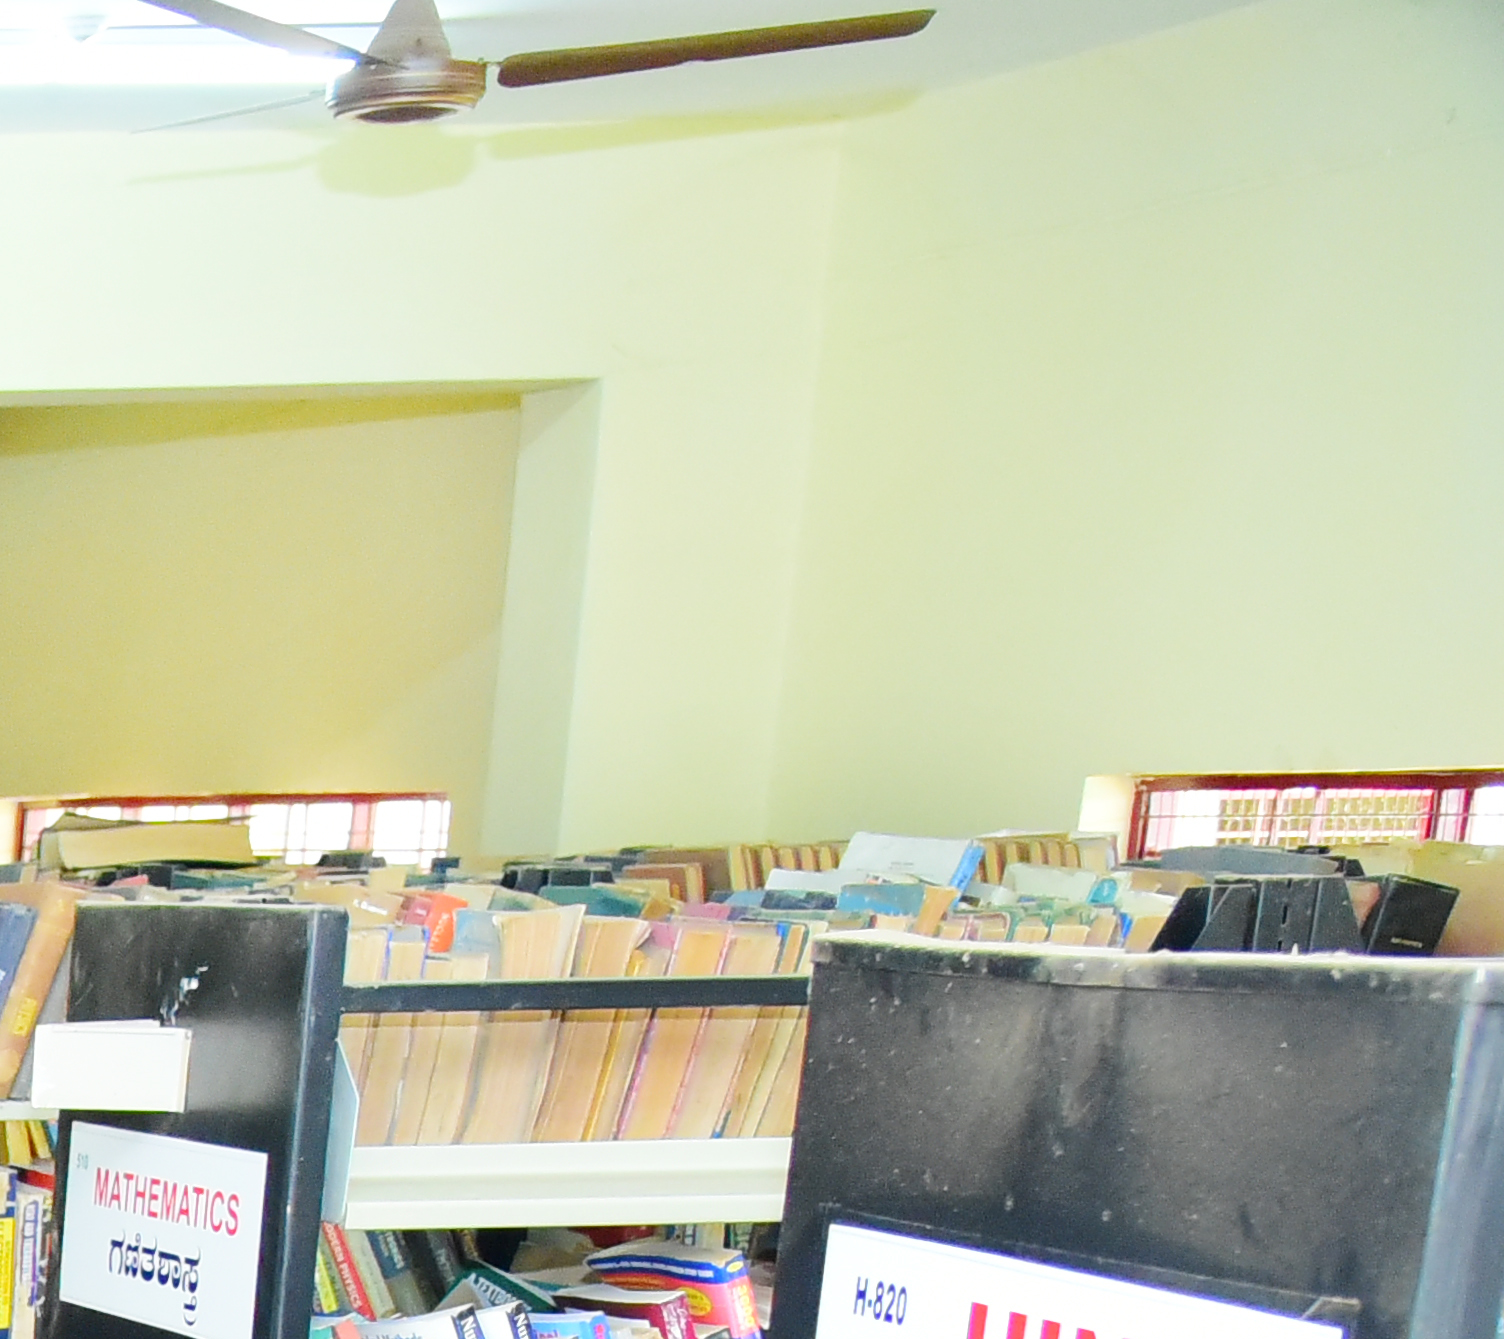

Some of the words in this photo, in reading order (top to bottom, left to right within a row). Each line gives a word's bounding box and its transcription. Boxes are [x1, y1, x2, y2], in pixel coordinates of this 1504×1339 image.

[94, 1167, 240, 1237] MATHEMATICS
[107, 1231, 202, 1326] ಗಣಿತಶಾಸ್ತ್ರ
[853, 1276, 907, 1326] H-820
